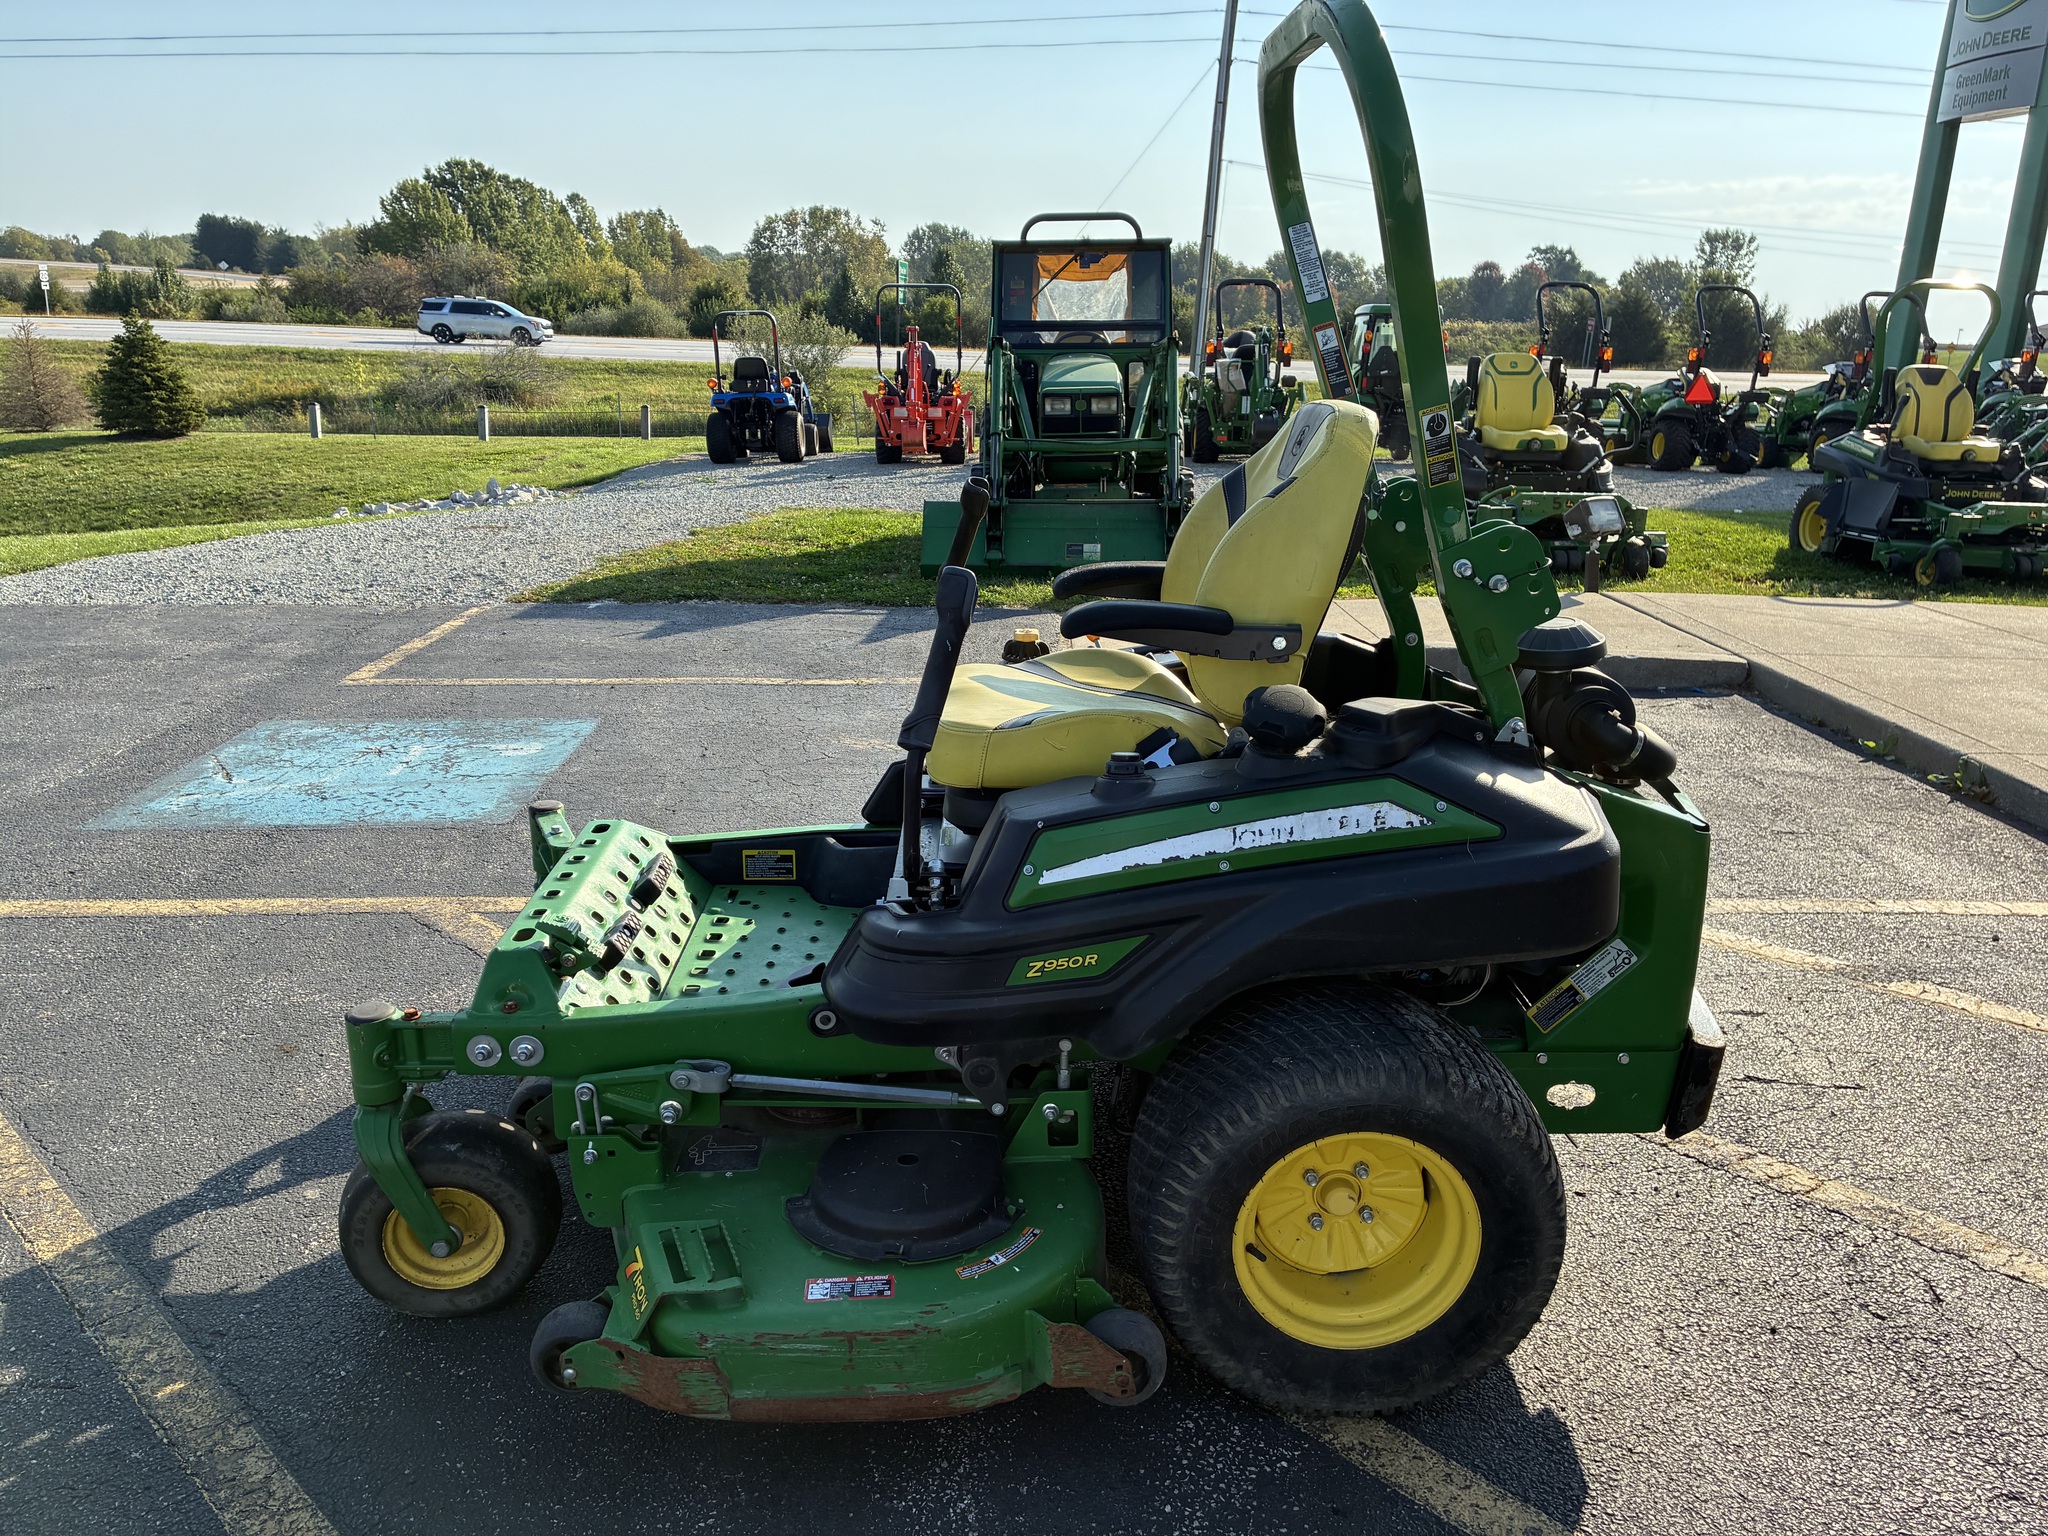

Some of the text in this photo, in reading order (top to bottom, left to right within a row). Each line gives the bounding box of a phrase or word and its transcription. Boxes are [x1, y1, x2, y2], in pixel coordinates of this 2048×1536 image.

[1953, 26, 2032, 57] JOHN DEERE
[1956, 64, 2011, 90] GreenMark
[1952, 84, 2008, 111] Equipment
[1945, 489, 2002, 498] JOHN DEERE
[1026, 954, 1098, 978] Z950R
